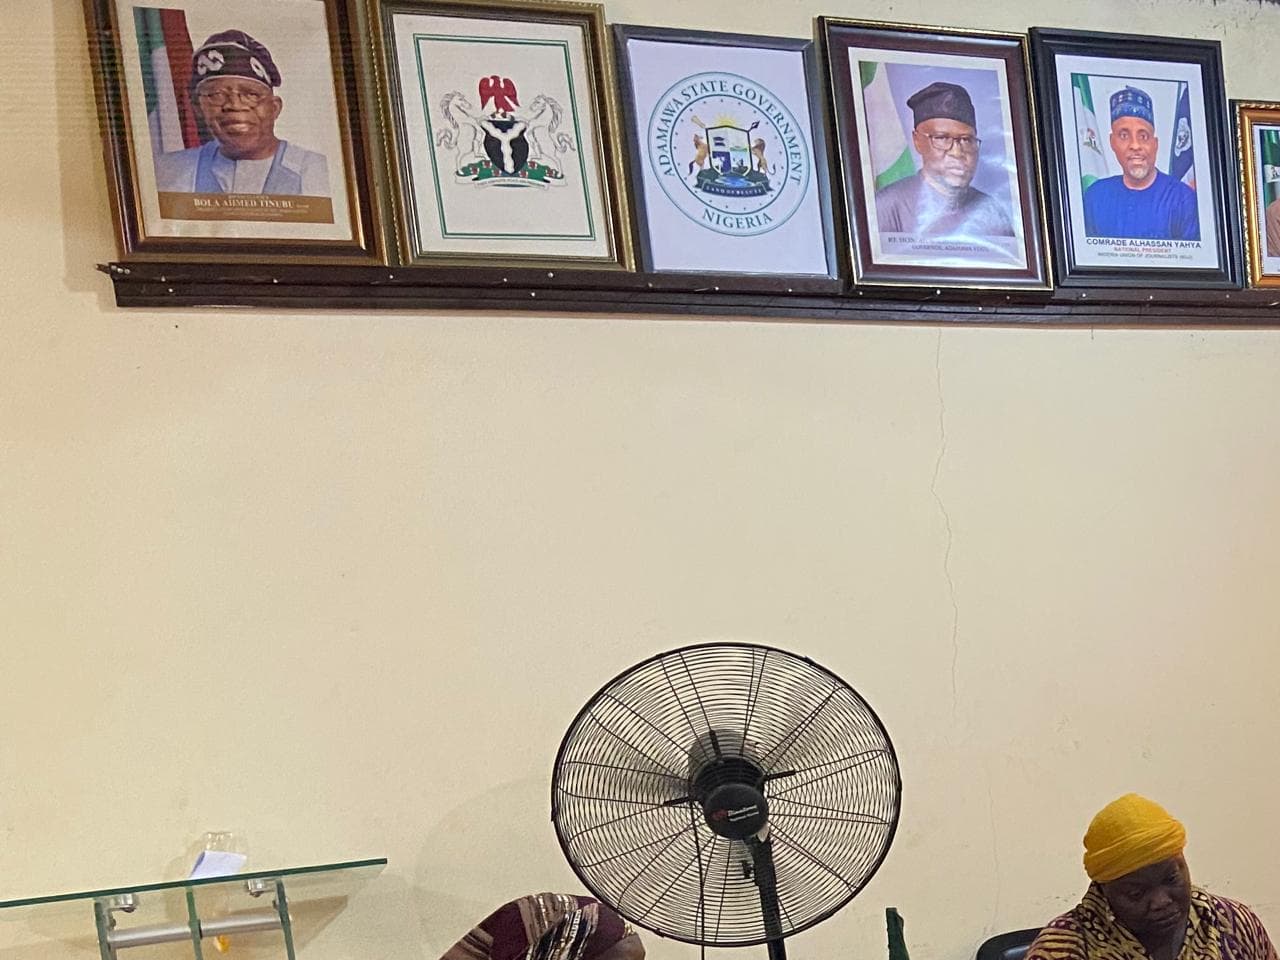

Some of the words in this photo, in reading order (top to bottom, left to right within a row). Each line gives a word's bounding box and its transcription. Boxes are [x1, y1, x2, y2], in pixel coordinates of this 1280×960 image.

[656, 97, 684, 177] ADAMAWA
[681, 80, 729, 100] STATE
[733, 83, 802, 186] GOVERNMENT
[194, 198, 221, 208] BOLA
[223, 199, 257, 208] AHMED
[260, 199, 294, 209] TINUBU
[702, 208, 773, 229] NIGERIA
[1086, 238, 1127, 247] COMRADE
[1129, 239, 1173, 248] ALHASSAN
[1174, 241, 1202, 249] YAHYA
